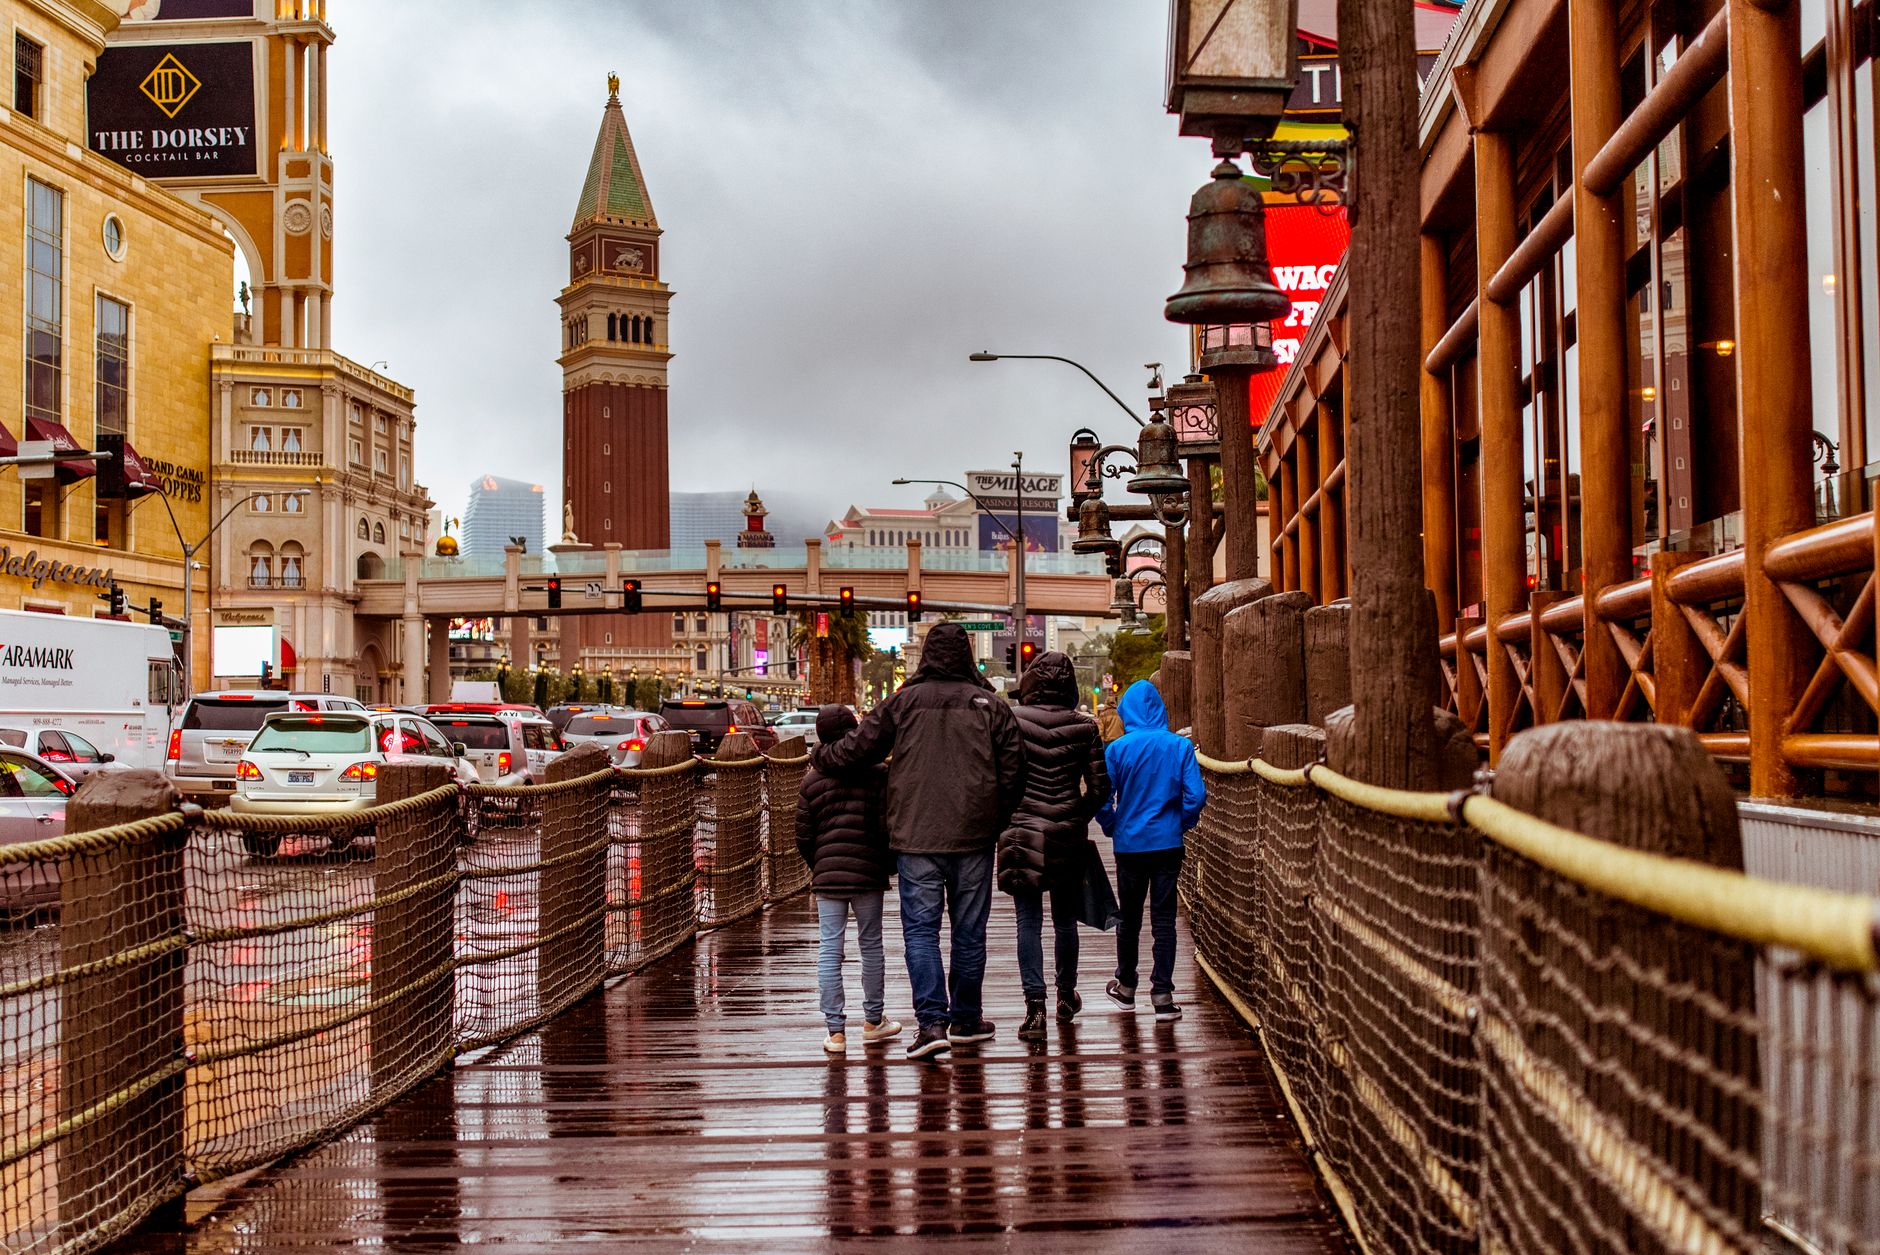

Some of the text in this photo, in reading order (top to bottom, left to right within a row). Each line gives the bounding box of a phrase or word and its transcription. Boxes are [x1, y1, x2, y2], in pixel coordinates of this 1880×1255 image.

[95, 127, 249, 150] THE DORSEY
[126, 151, 219, 163] COCKTAIL BAR
[141, 456, 174, 476] GRAND
[176, 465, 206, 484] CANAL
[157, 475, 201, 503] OPPES
[975, 475, 1059, 493] THE MIRAGE
[1022, 500, 1057, 509] RESORT
[220, 612, 266, 624] Walgreens
[2, 645, 74, 670] ARAMARK
[2, 676, 22, 687] Managed
[23, 677, 40, 686] Services,
[41, 678, 60, 688] Managed
